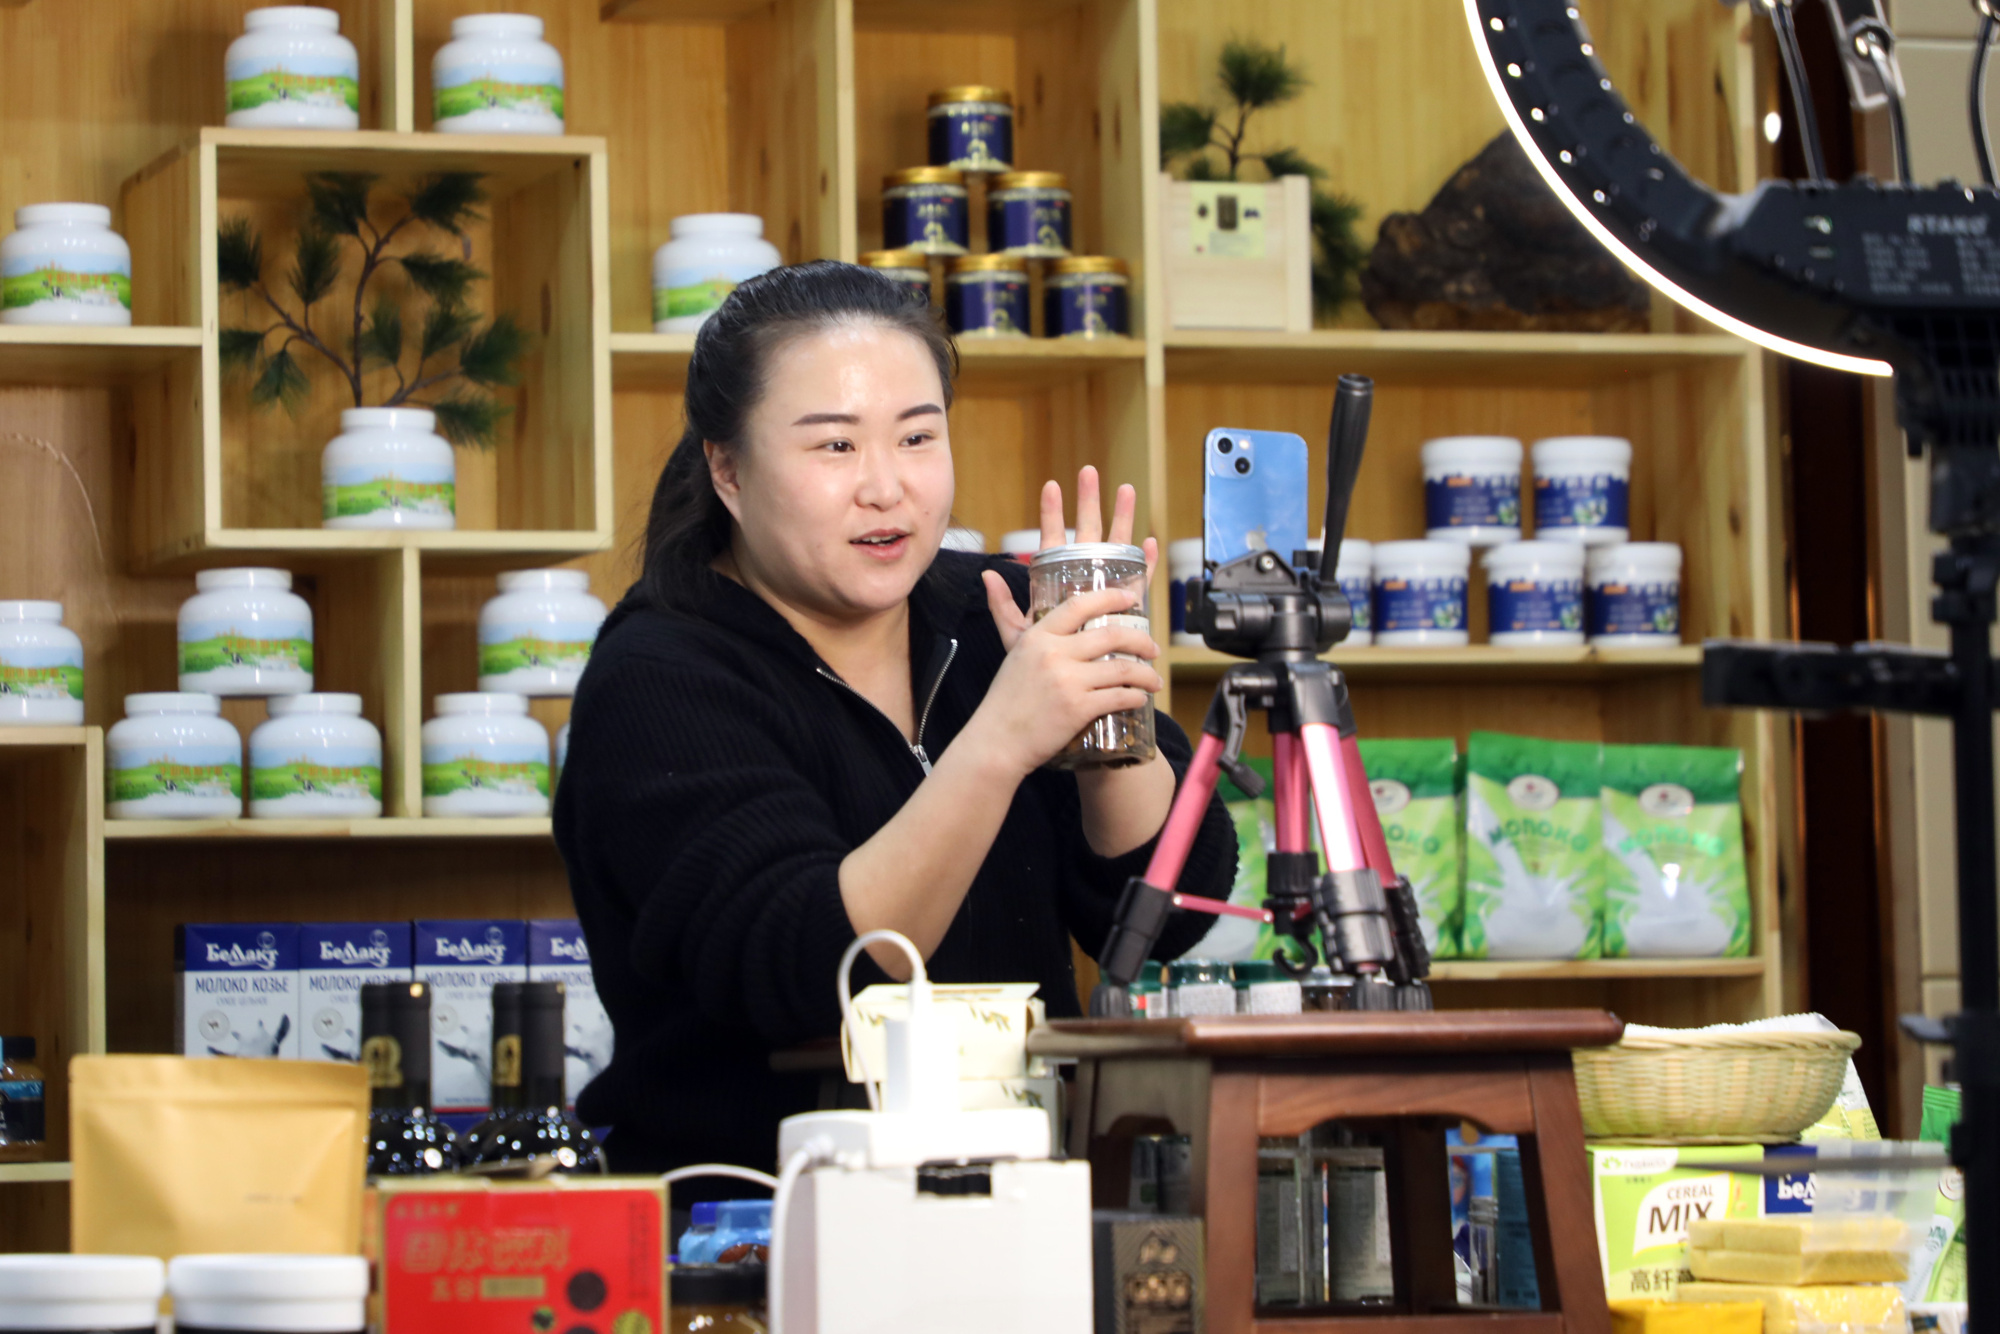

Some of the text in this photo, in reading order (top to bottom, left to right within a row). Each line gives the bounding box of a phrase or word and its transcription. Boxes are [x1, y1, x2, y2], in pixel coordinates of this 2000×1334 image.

[195, 976, 289, 994] МОЛОКО КОЗЬЕ
[309, 974, 361, 992] МОЛОКО
[1667, 1184, 1715, 1200] CEREAL
[1648, 1201, 1713, 1235] MIX
